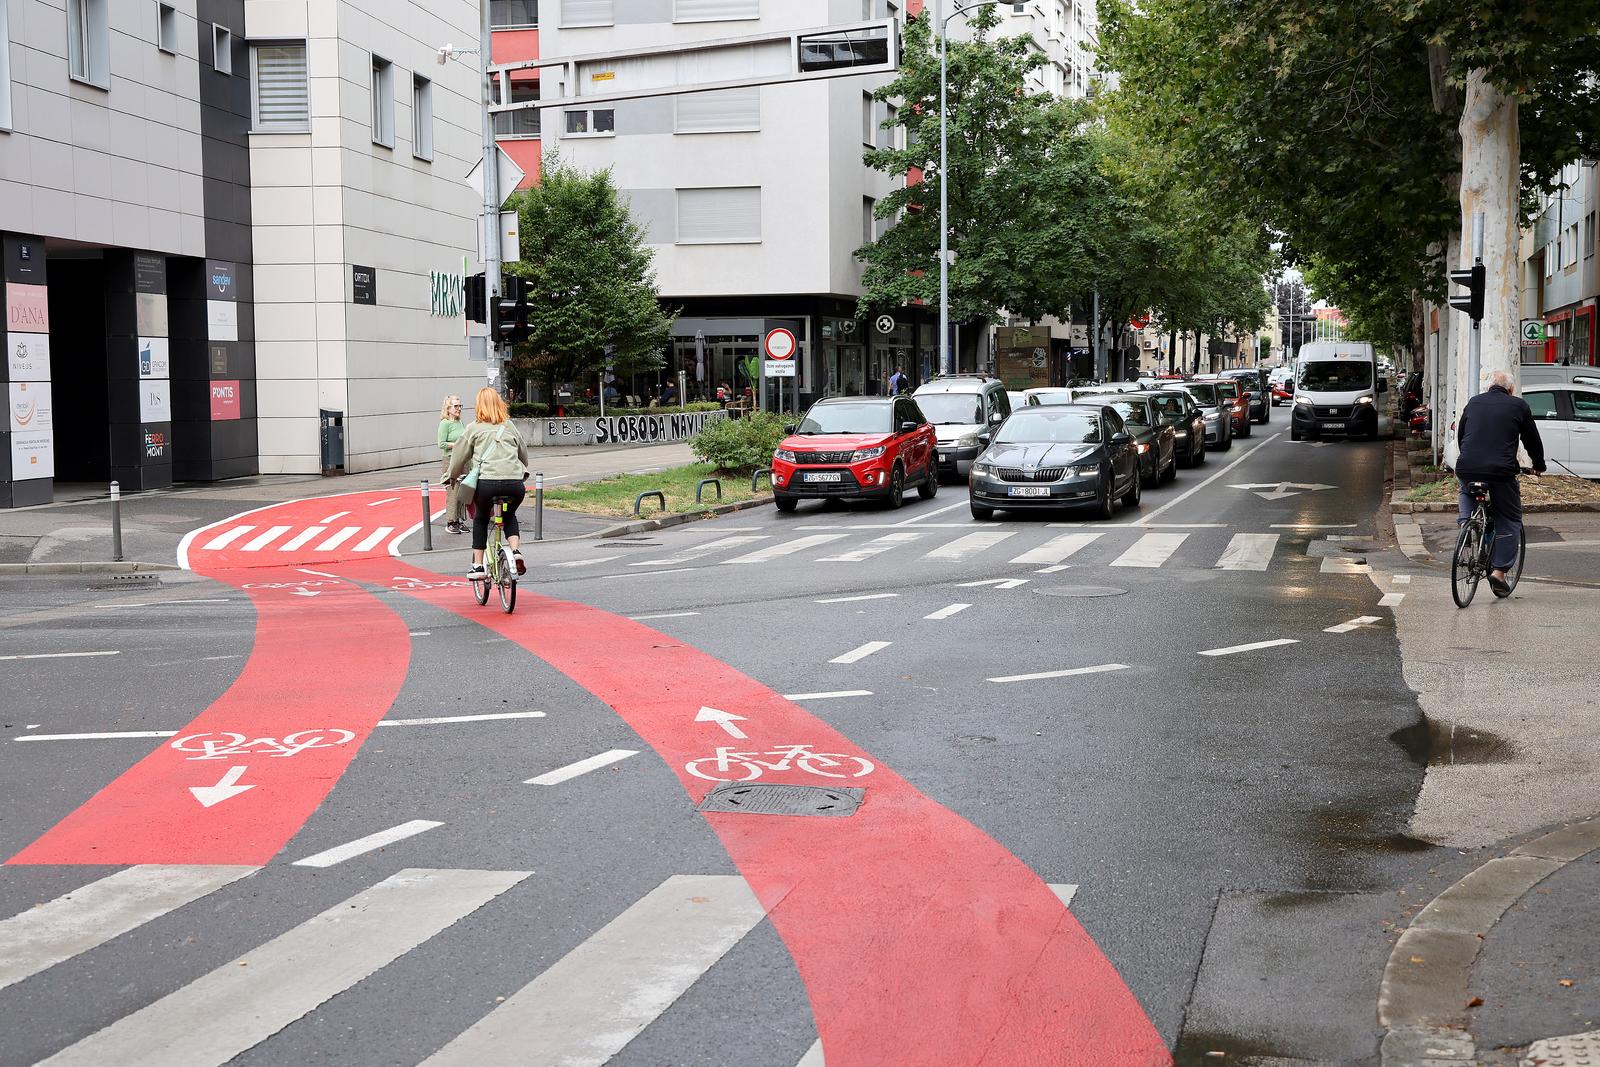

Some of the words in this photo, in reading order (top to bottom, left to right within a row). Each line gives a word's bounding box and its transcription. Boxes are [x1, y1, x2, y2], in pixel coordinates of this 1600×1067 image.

[595, 414, 666, 443] SLOBODA
[145, 433, 164, 444] FERRO
[146, 447, 163, 457] MONT
